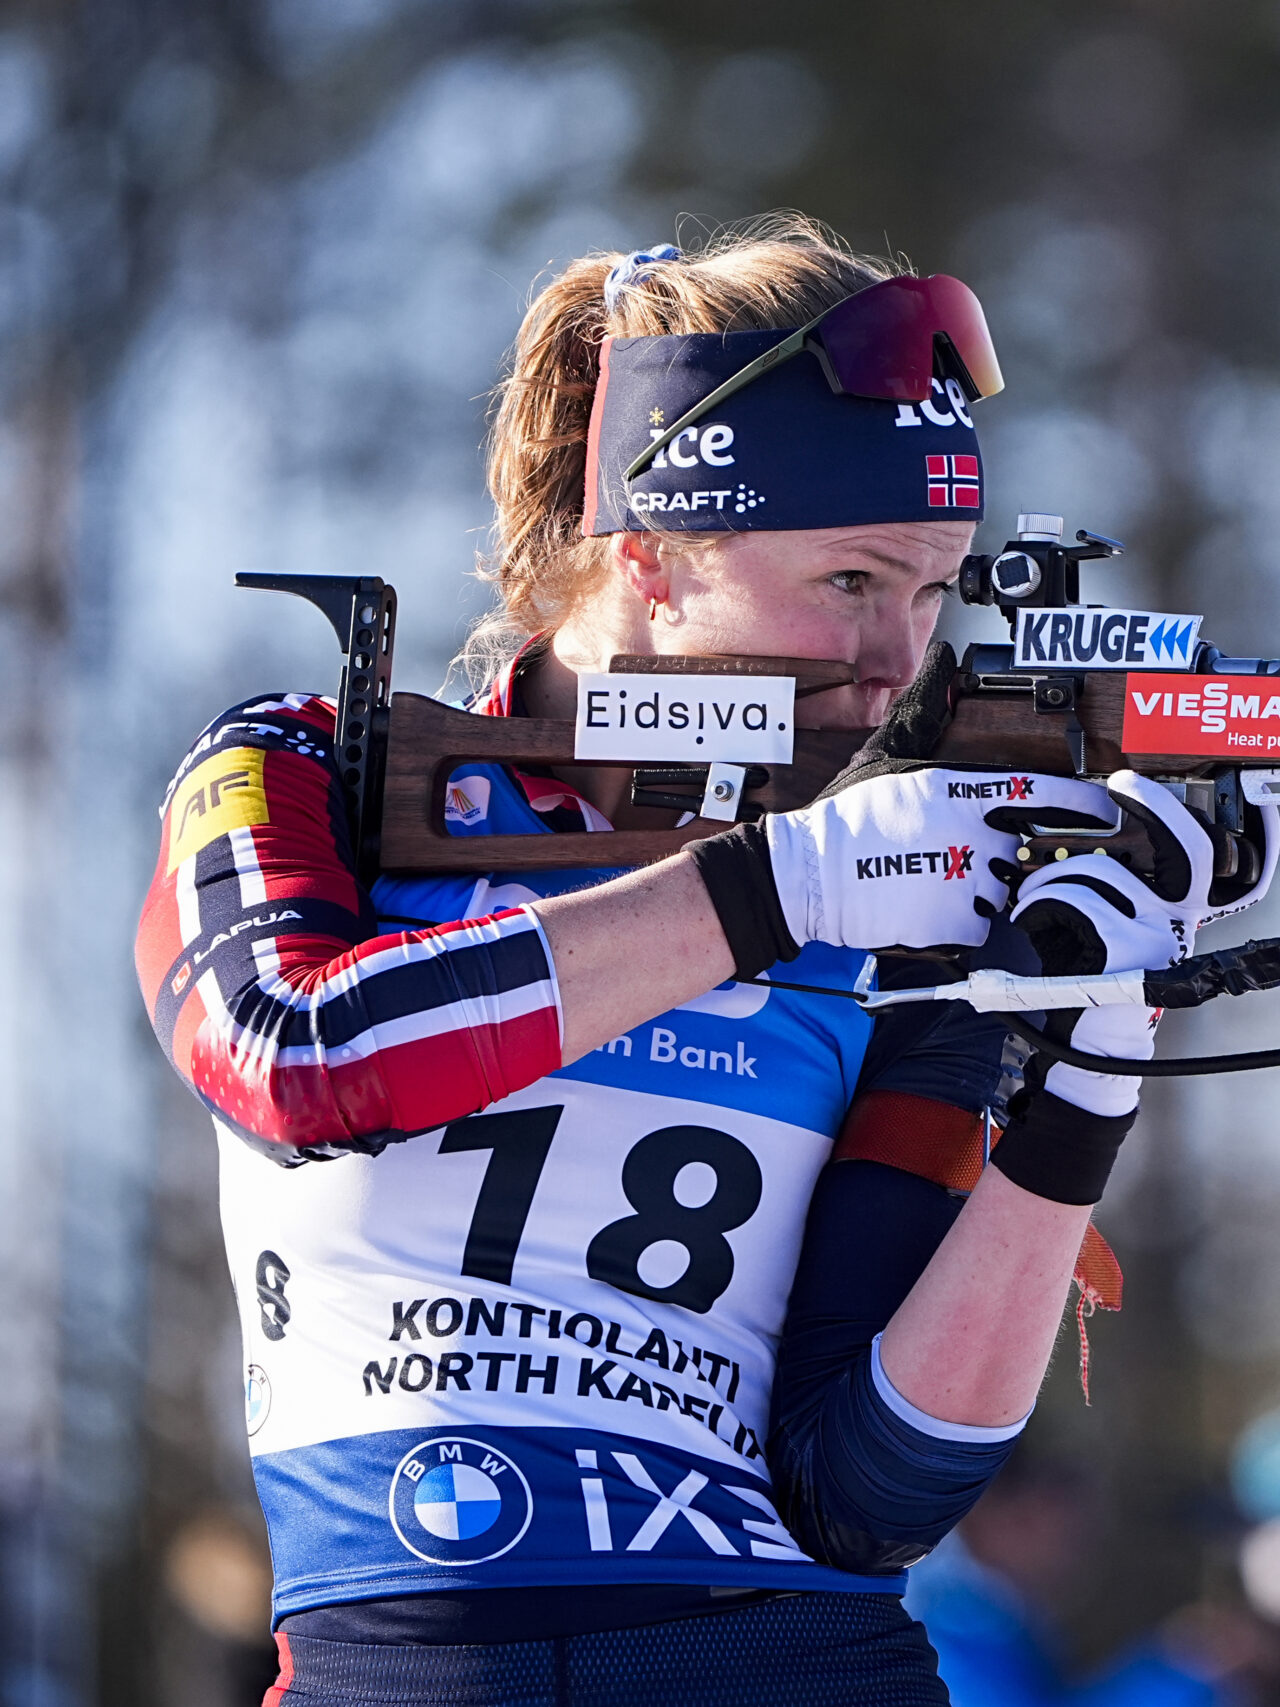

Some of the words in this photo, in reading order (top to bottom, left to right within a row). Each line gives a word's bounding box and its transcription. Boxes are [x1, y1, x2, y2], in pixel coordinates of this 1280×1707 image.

[649, 425, 735, 468] ice
[631, 491, 732, 511] CRAFT
[1022, 613, 1150, 662] KRUGE
[1227, 733, 1263, 747] Heat
[948, 777, 1034, 800] KINETIXX
[856, 845, 974, 880] KINETIXX
[193, 910, 303, 964] LAPUA
[650, 1027, 758, 1079] Bank
[438, 1104, 762, 1314] 18
[389, 1298, 740, 1403] KONTIOLAHTI
[363, 1352, 559, 1396] NORTH
[403, 1444, 507, 1482] BMW
